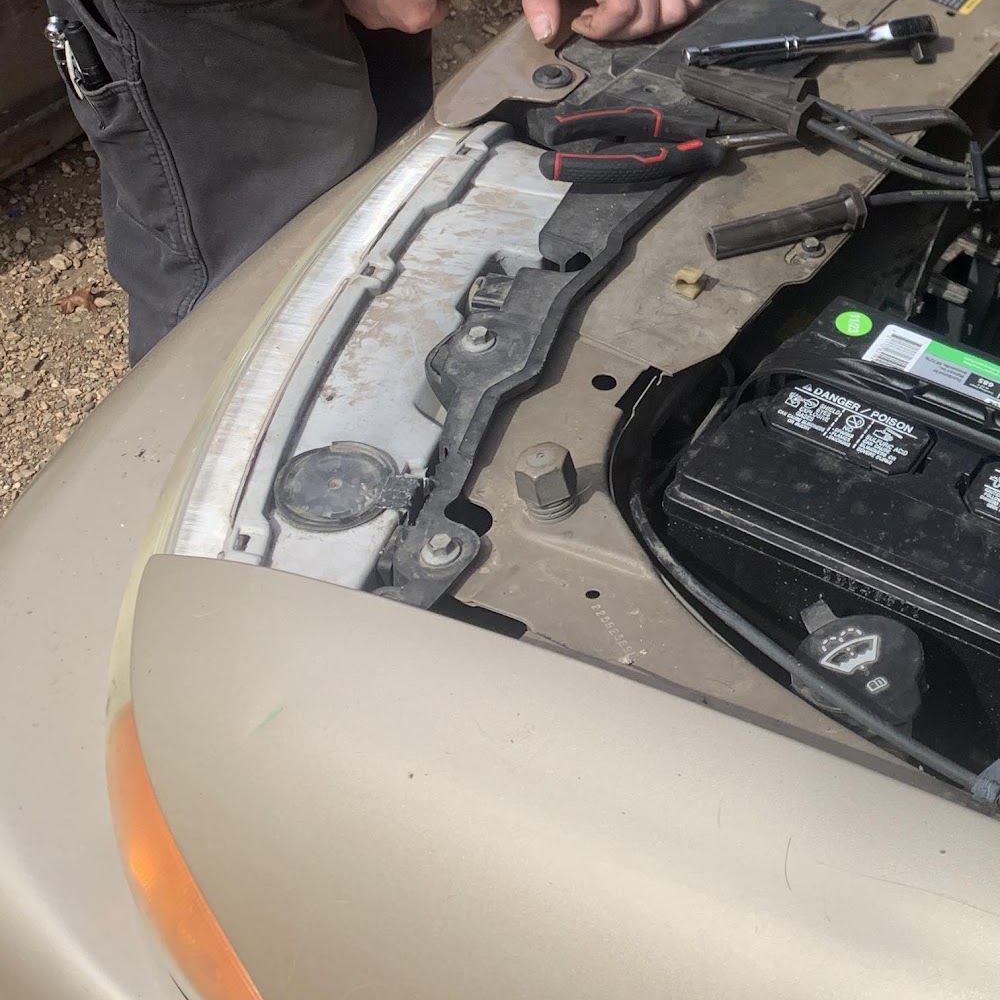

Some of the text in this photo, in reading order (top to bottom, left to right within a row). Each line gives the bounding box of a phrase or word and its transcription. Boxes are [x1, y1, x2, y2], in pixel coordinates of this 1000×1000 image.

[977, 378, 994, 387] 685
[813, 387, 860, 410] DANGER
[870, 411, 913, 432] POISON
[893, 447, 908, 455] ACID
